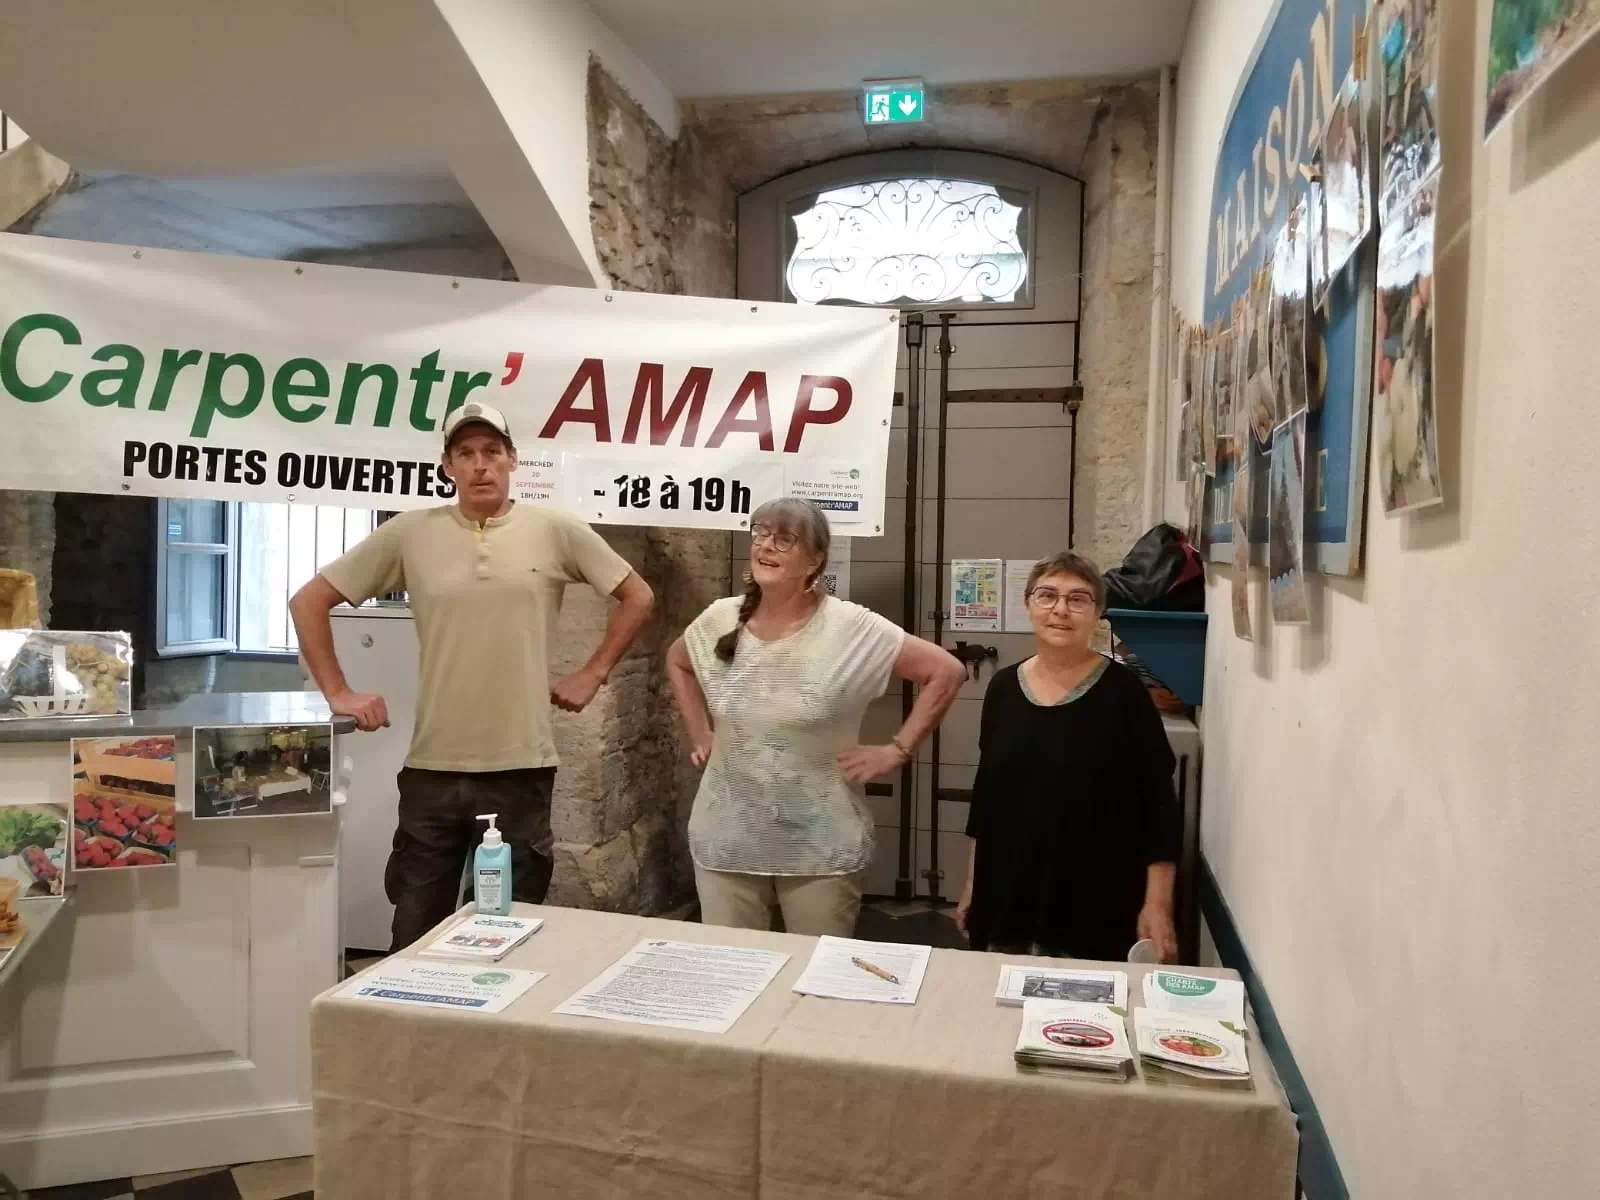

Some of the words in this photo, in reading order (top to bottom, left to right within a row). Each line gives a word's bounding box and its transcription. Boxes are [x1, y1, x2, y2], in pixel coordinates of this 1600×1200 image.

[1213, 0, 1335, 297] MAISON
[538, 358, 853, 453] AMAP
[123, 440, 267, 486] PORTES
[277, 451, 457, 498] OUVERTES
[614, 474, 651, 508] 18
[660, 474, 680, 510] à
